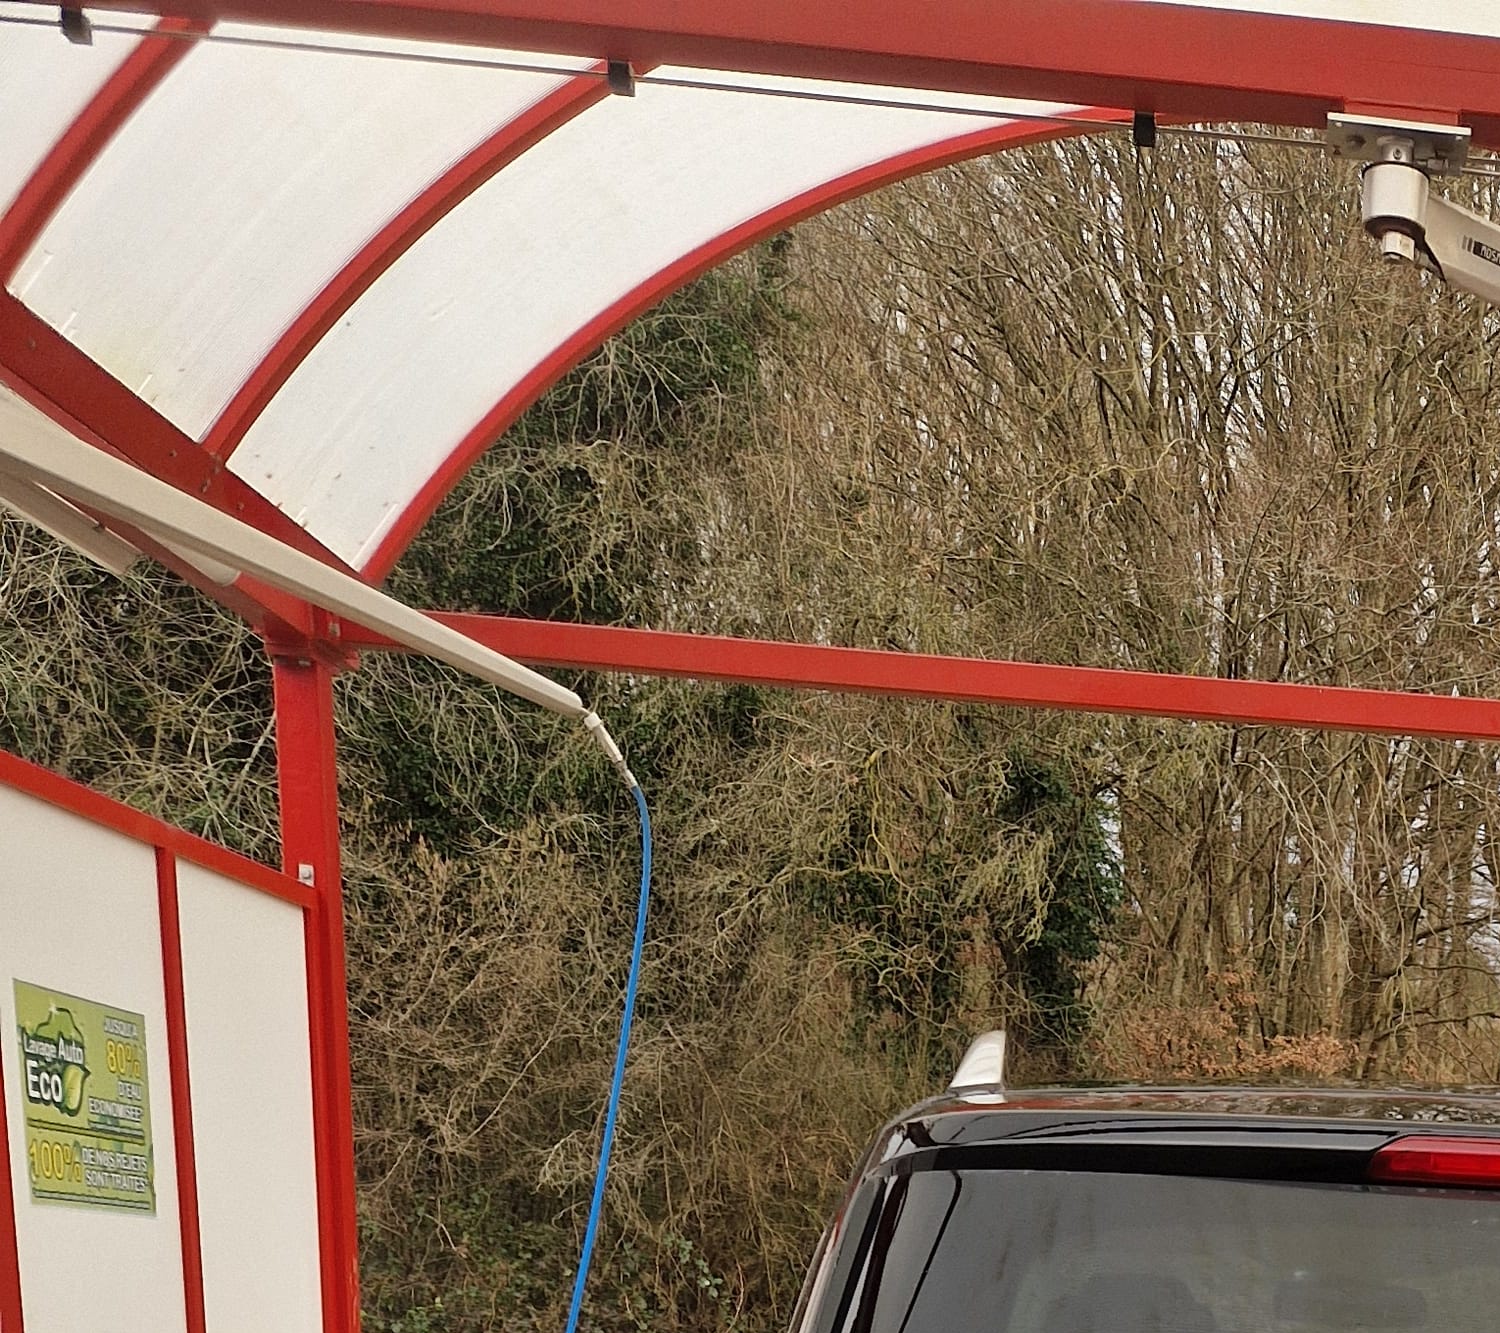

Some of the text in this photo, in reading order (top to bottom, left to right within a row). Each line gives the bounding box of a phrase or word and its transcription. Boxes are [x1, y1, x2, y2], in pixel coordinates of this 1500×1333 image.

[23, 1033, 84, 1065] Lavage Auto
[106, 1039, 142, 1078] 80%
[26, 1059, 63, 1103] Eco
[29, 1139, 81, 1183] 100%
